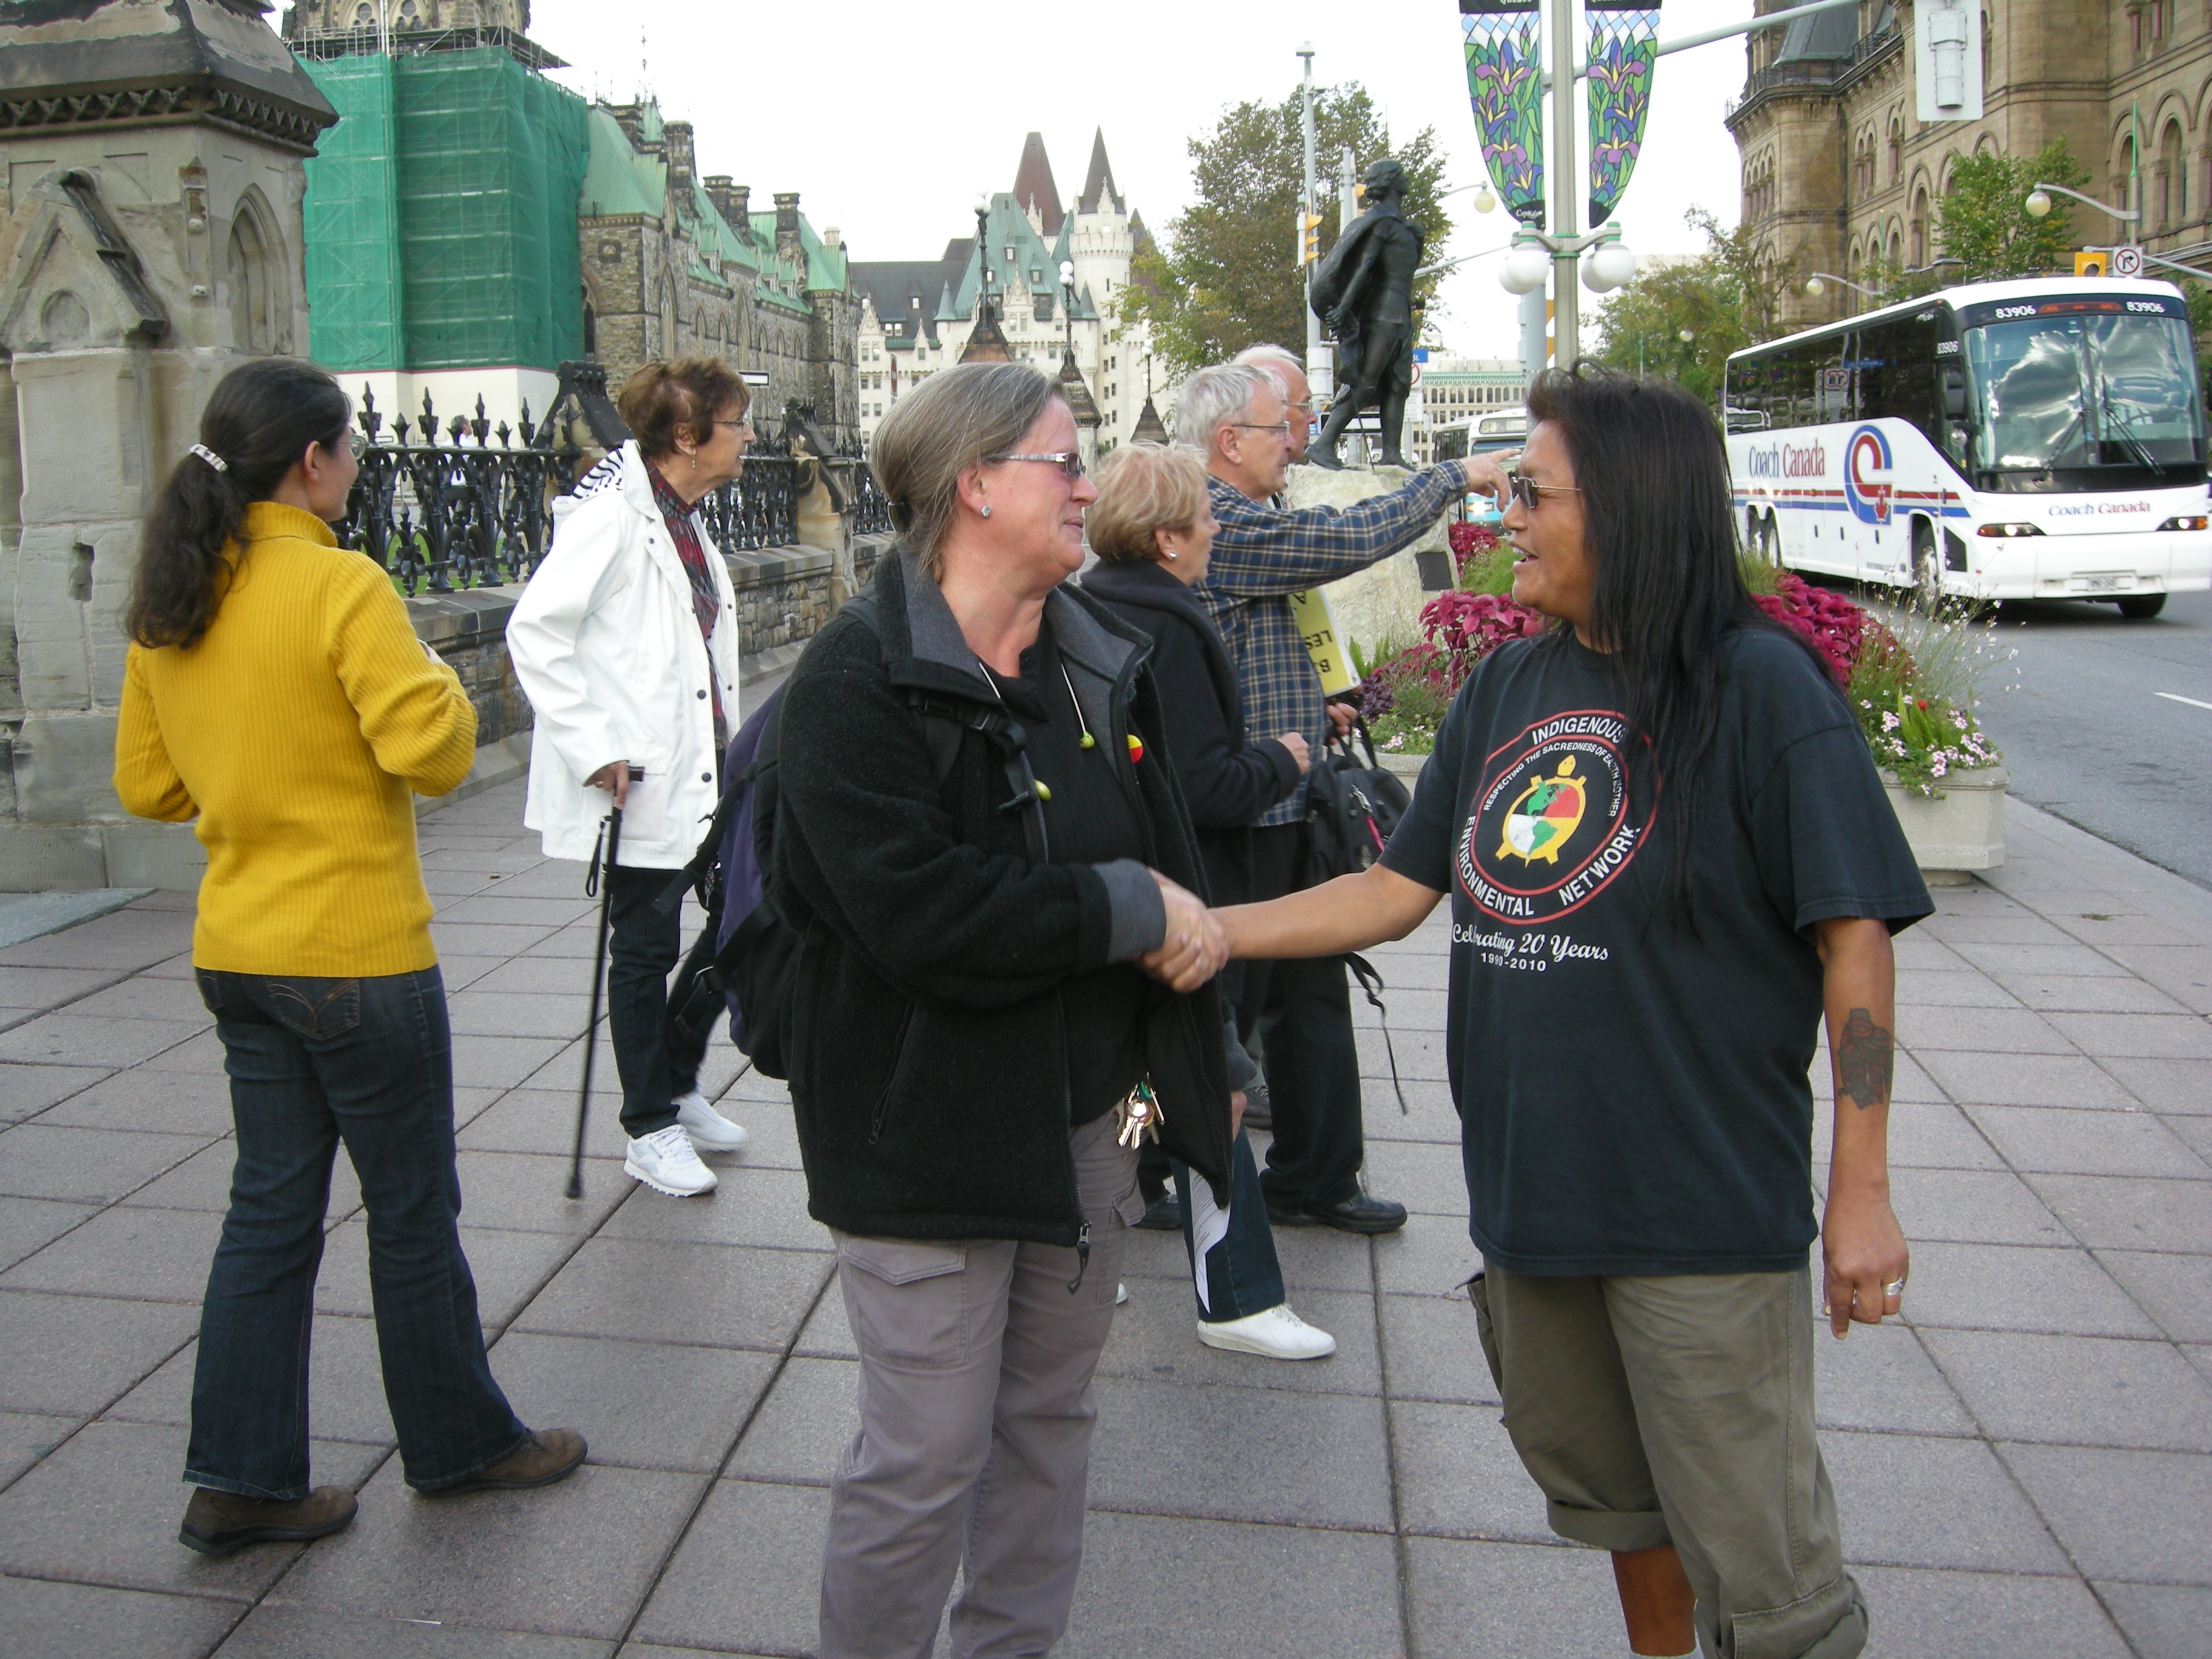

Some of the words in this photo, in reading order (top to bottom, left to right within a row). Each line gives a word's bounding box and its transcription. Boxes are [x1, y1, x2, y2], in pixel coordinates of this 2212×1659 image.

[1995, 304, 2037, 319] 83906
[2125, 301, 2165, 313] 83906
[1937, 340, 1959, 355] 83906
[1749, 441, 1780, 478] Coach
[1783, 438, 1825, 478] Canada
[2049, 503, 2094, 516] Coach
[2098, 501, 2151, 514] Canada
[1532, 716, 1624, 745] INDIGENOUS
[1483, 762, 1525, 811] RESPECTING
[1525, 749, 1541, 765] THE
[1543, 742, 1596, 755] SACREDNESS
[1594, 747, 1607, 758] OF
[1458, 816, 1535, 916] ENVIRONMENTAL
[1558, 823, 1640, 907] NETWORK
[1452, 923, 1516, 957] Celbrating
[1518, 932, 1546, 954] 20
[1550, 934, 1609, 963] Years
[1480, 951, 1547, 972] 1990-2010
